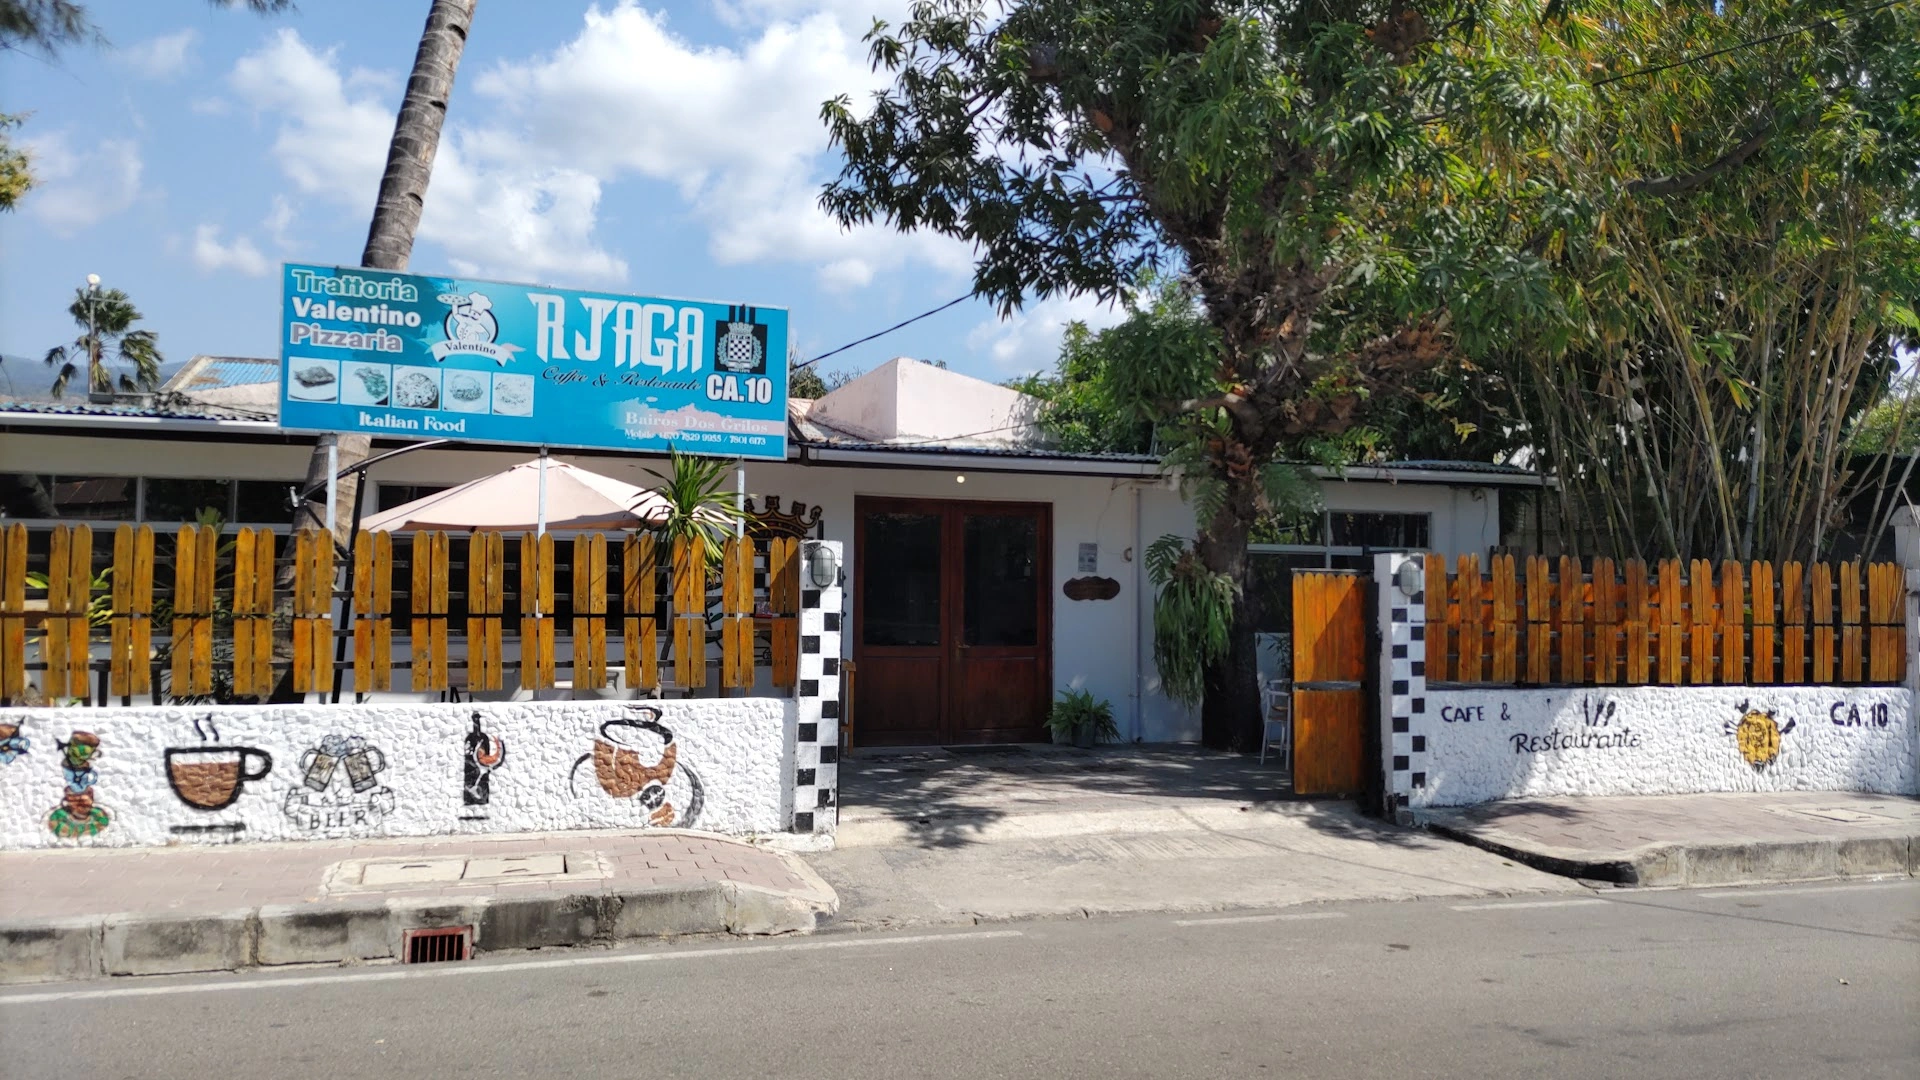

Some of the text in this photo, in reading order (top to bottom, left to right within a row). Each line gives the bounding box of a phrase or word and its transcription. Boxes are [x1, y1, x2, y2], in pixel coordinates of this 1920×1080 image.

[291, 269, 418, 302] Trattoria
[291, 297, 422, 328] Valentino
[290, 322, 404, 353] Pizzaria
[445, 342, 497, 356] Valentino
[592, 373, 609, 387] &
[706, 374, 773, 404] CA.10
[359, 411, 466, 433] Italian Food
[625, 411, 769, 433] Bairos Dos Grilos
[1441, 702, 1512, 723] CAFE &
[1830, 701, 1888, 728] CA.10
[1509, 727, 1642, 755] Restaurante
[310, 809, 369, 830] BEER
